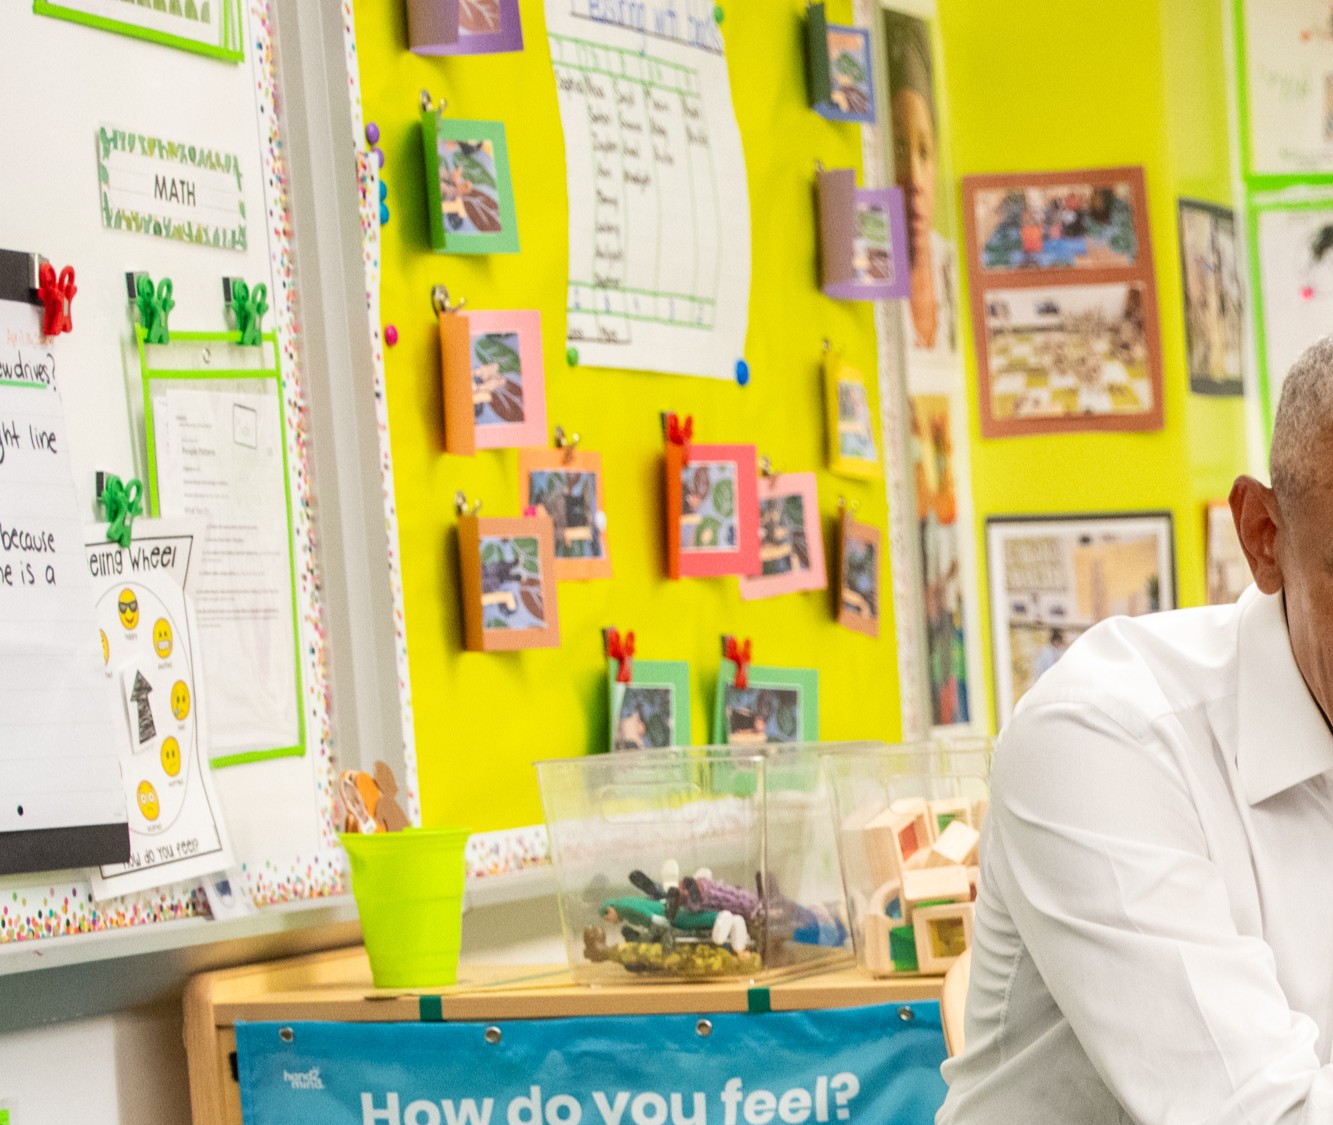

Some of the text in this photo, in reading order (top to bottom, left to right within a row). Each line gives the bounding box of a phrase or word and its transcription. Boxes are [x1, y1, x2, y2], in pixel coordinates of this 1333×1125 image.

[154, 174, 197, 207] MATH
[29, 424, 57, 454] line
[0, 523, 55, 552] because
[20, 561, 35, 585] is
[45, 564, 56, 585] a
[144, 848, 155, 864] do
